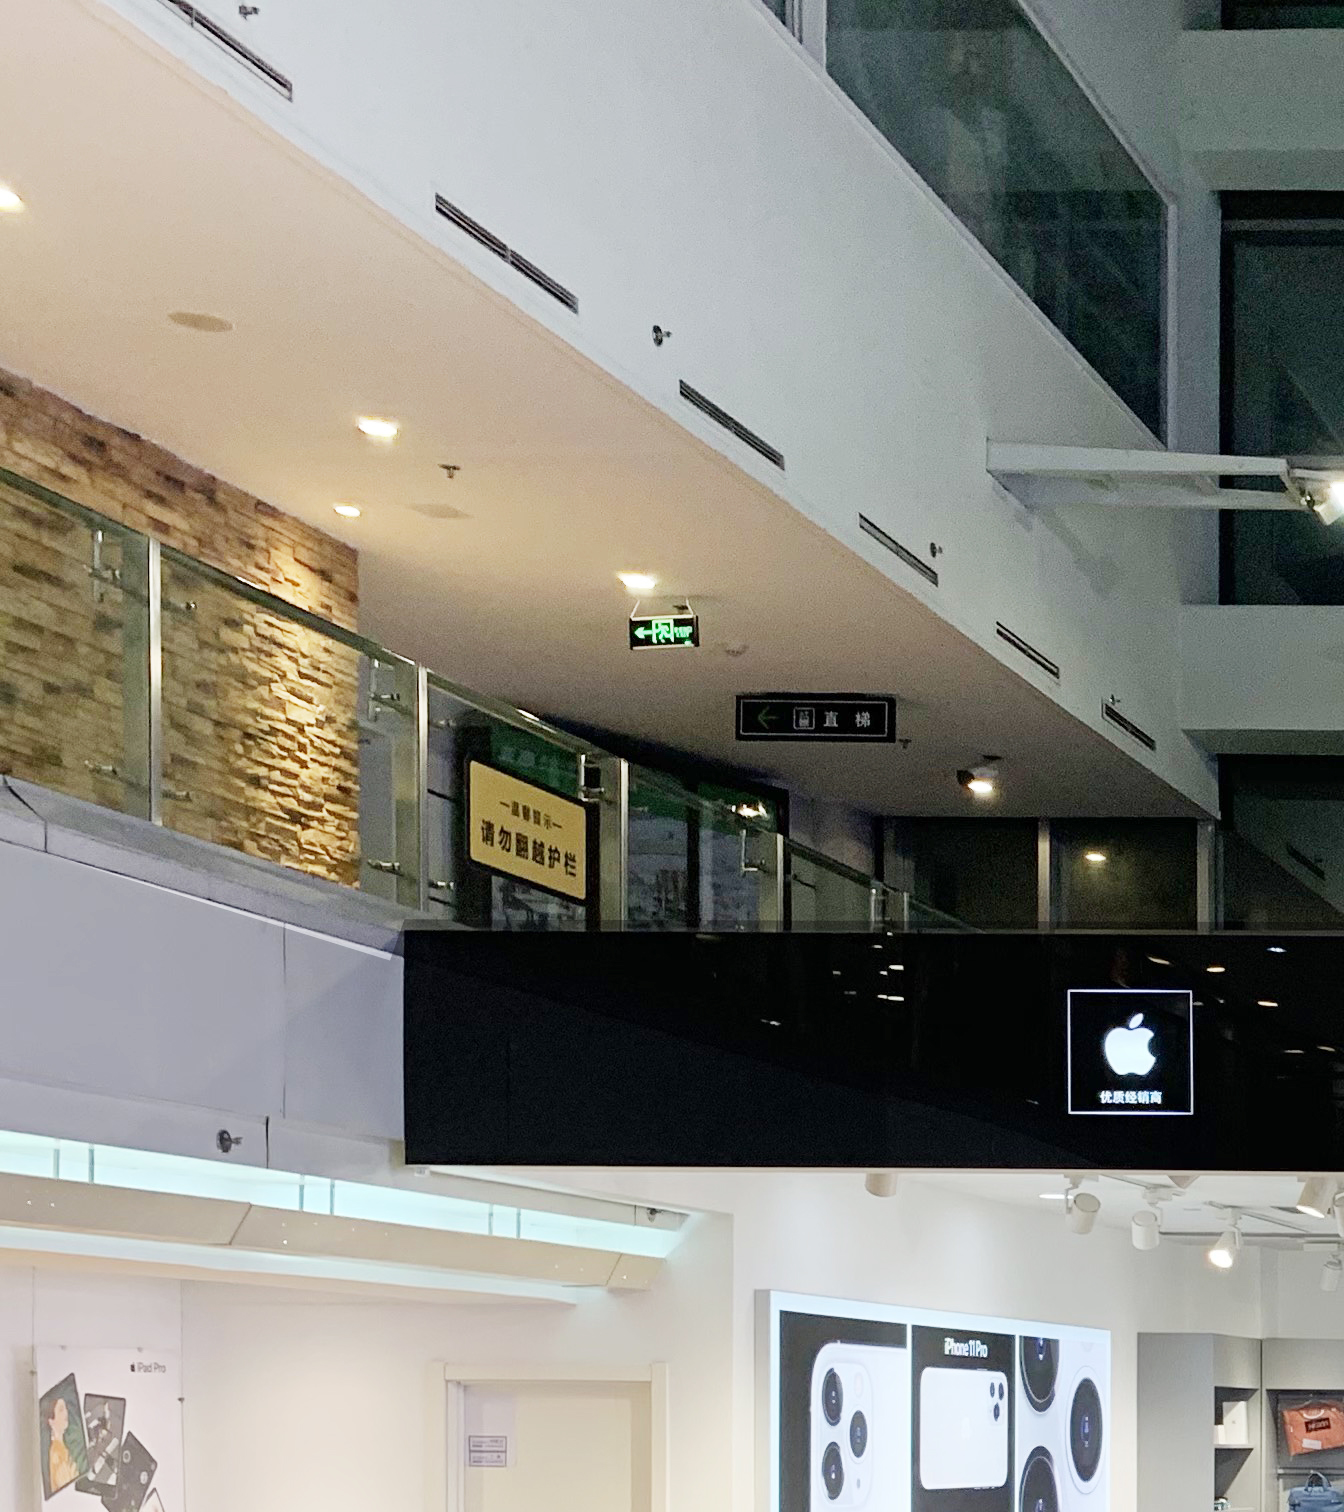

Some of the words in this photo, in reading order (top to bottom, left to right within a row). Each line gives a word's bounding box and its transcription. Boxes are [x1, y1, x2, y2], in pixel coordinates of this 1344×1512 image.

[480, 819, 577, 877] 请勿翻越护栏
[1099, 1090, 1162, 1104] 优质经销商
